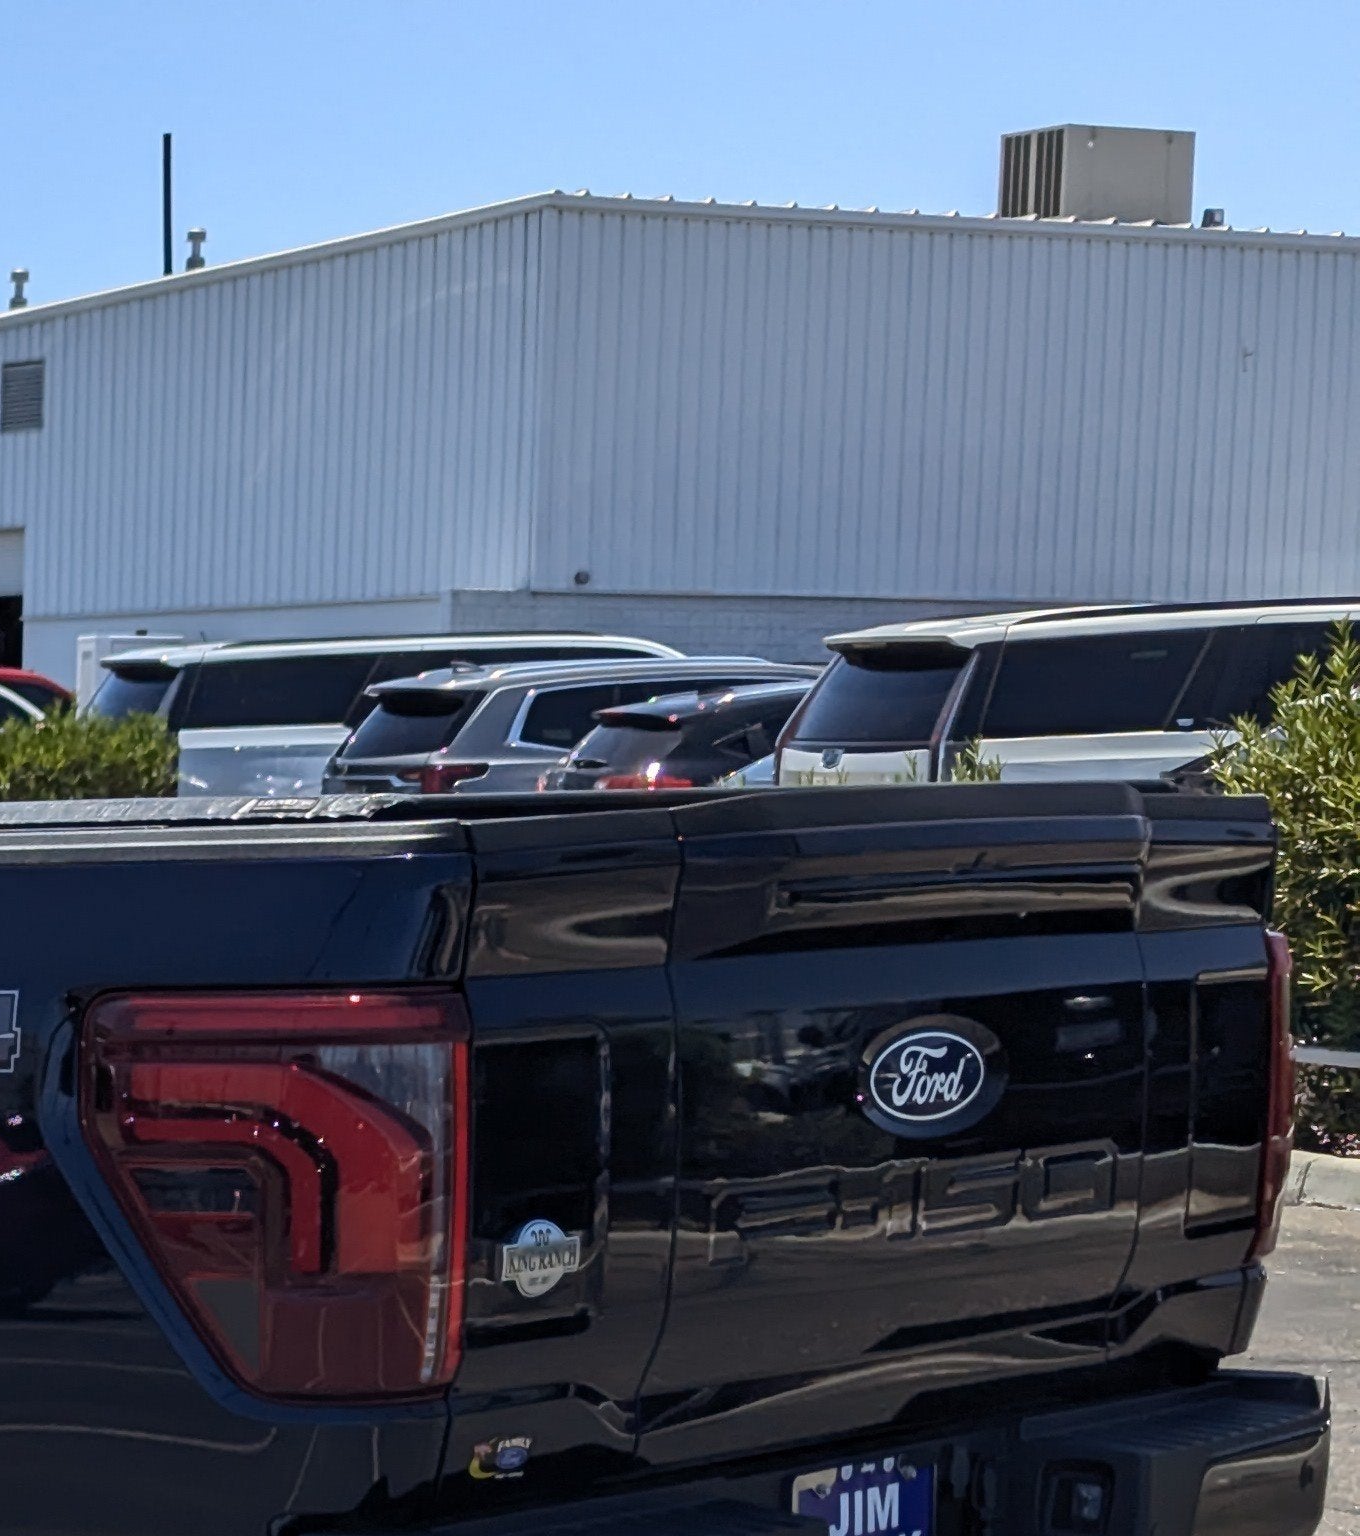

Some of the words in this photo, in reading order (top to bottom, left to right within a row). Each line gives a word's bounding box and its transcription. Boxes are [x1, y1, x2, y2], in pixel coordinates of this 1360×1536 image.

[891, 1045, 971, 1107] Ford
[508, 1251, 536, 1275] KING
[538, 1243, 578, 1271] RANCH
